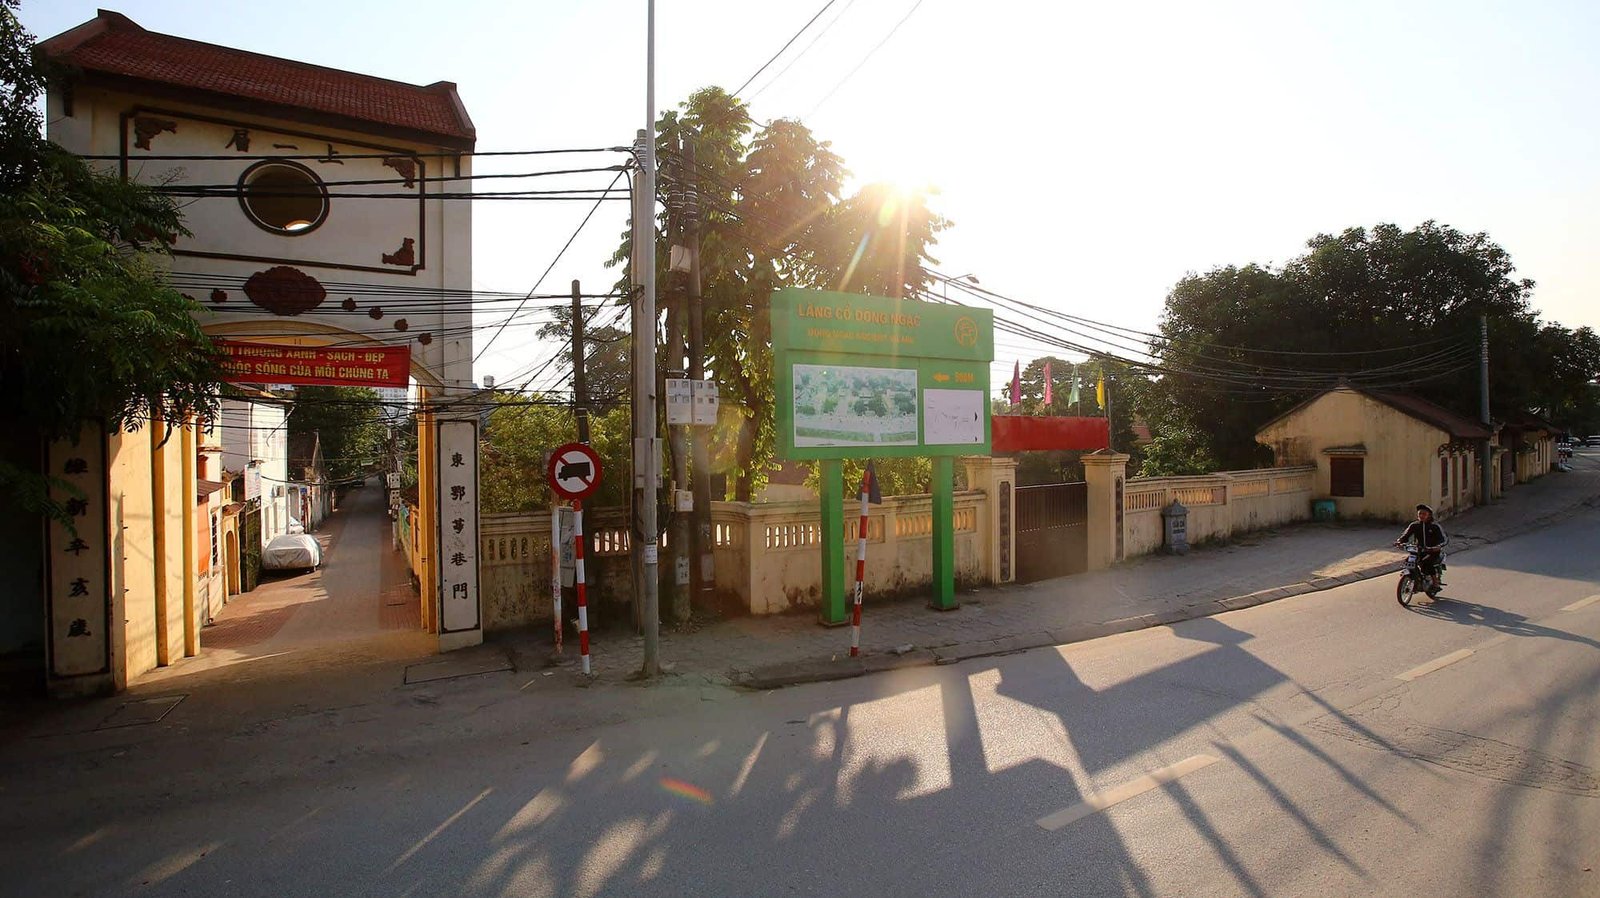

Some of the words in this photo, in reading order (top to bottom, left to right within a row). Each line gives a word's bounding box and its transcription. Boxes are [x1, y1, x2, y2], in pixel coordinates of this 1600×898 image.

[326, 351, 355, 363] SẠCH
[365, 352, 385, 365] ĐẸP
[255, 359, 287, 376] SỐNG
[289, 360, 312, 377] CỦA
[339, 365, 374, 379] CHÚNG
[377, 368, 389, 379] TA
